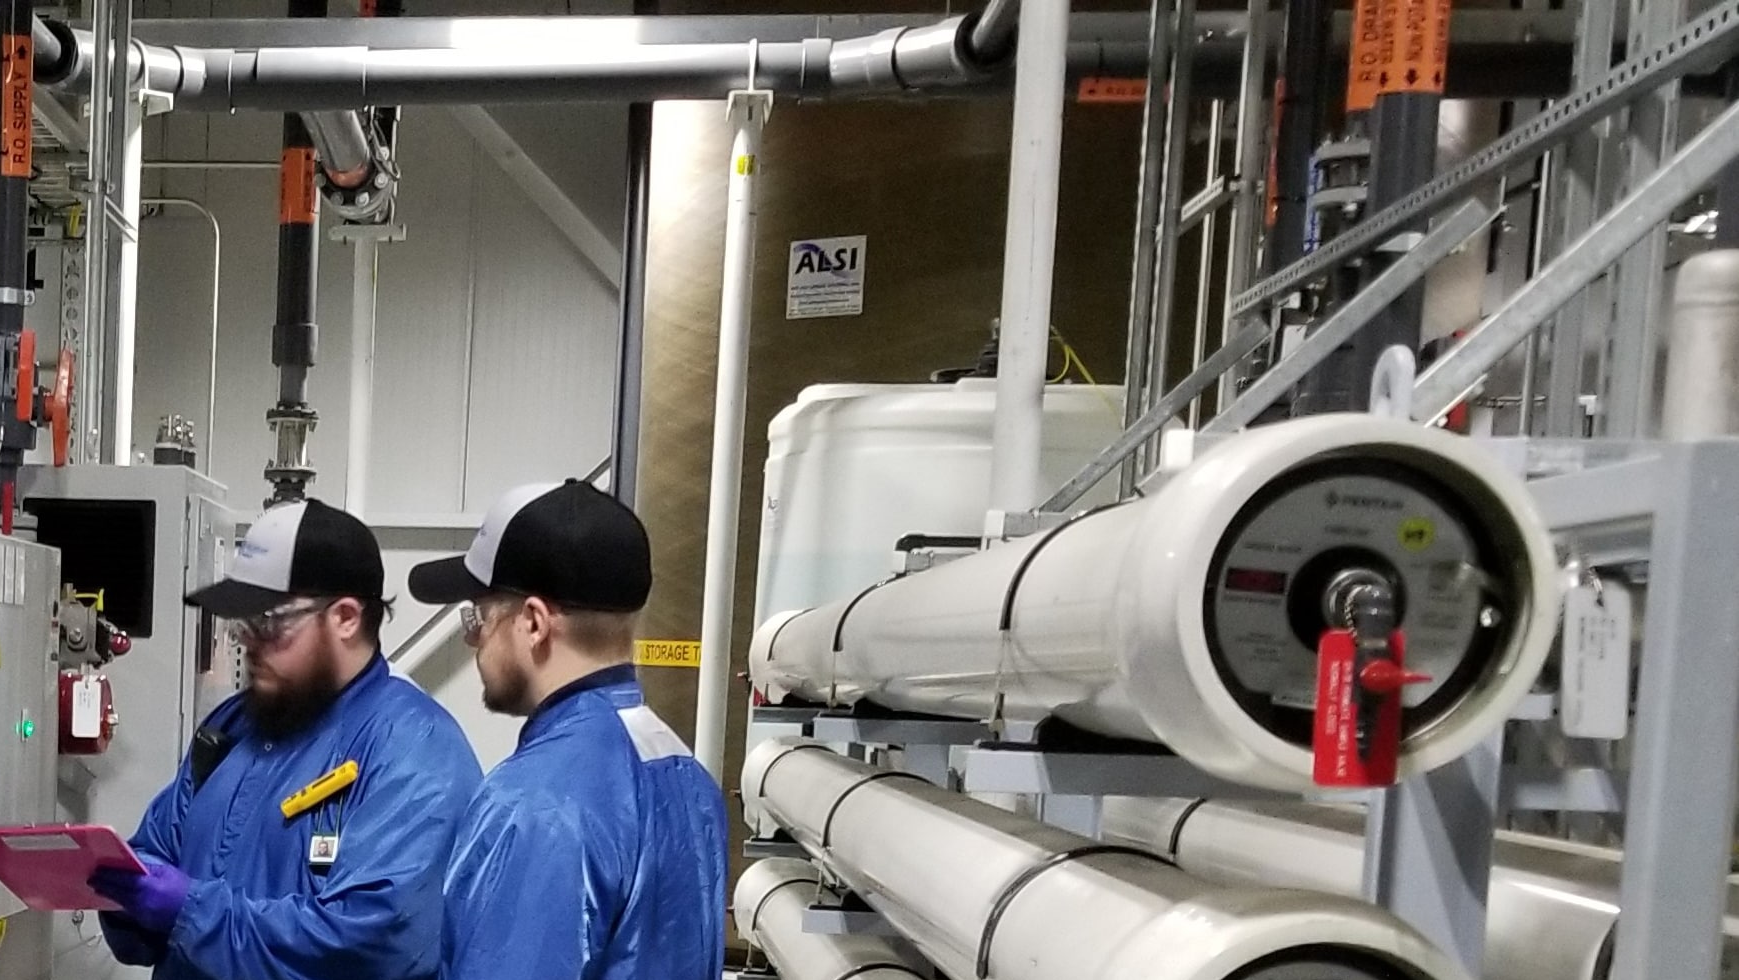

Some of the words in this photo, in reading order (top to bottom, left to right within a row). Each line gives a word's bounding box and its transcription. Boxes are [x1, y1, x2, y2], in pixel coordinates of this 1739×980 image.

[13, 71, 27, 131] SUPPLY
[795, 248, 858, 274] ALSI
[645, 644, 690, 661] STORAGE
